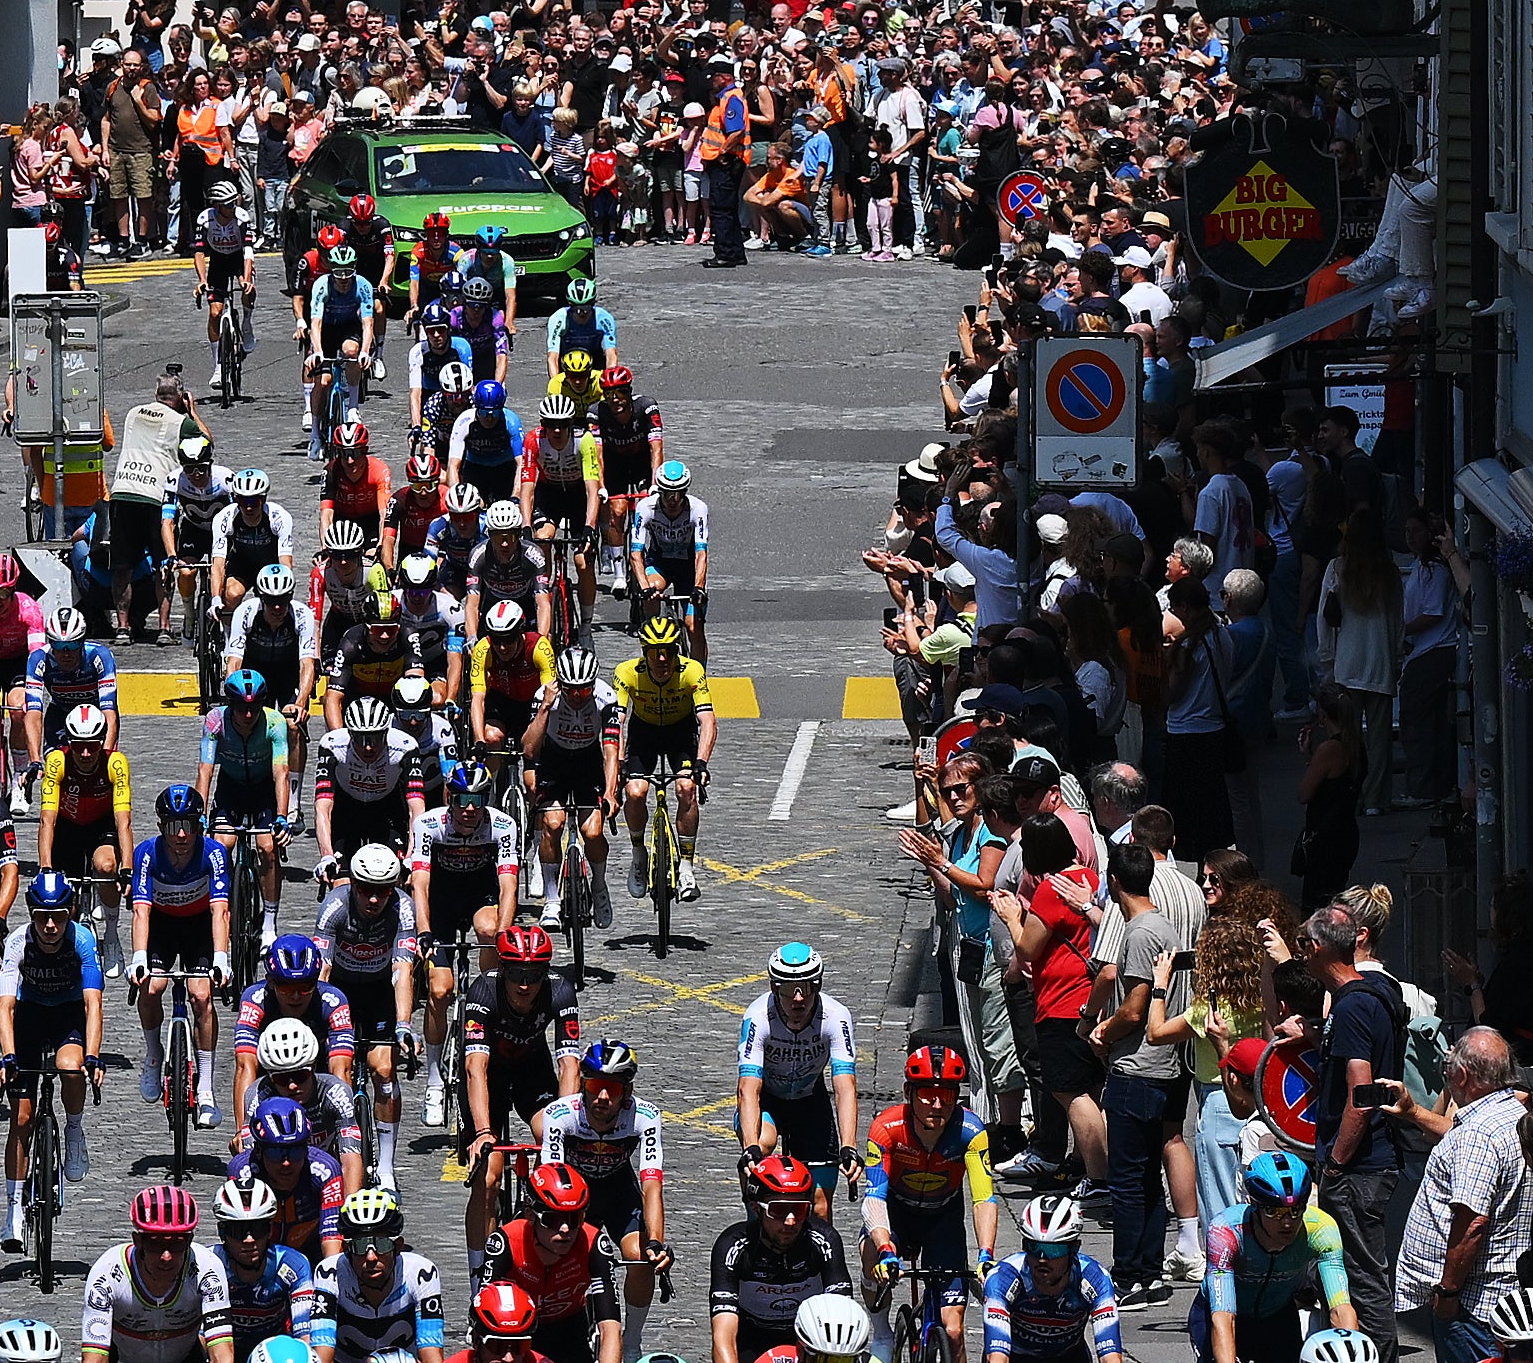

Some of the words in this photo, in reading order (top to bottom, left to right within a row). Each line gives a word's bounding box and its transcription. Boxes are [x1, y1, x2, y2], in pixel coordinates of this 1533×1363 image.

[1236, 174, 1287, 204] BIG
[439, 205, 544, 214] Europcar
[1204, 207, 1323, 246] BURGER
[138, 408, 164, 418] Nikon
[115, 471, 157, 486] WAGNER
[123, 461, 152, 472] FOTO
[744, 1022, 758, 1059] MERIDA
[840, 1019, 853, 1058] MERIDA
[550, 1127, 563, 1162] BOSS
[644, 1127, 658, 1161] BOSS
